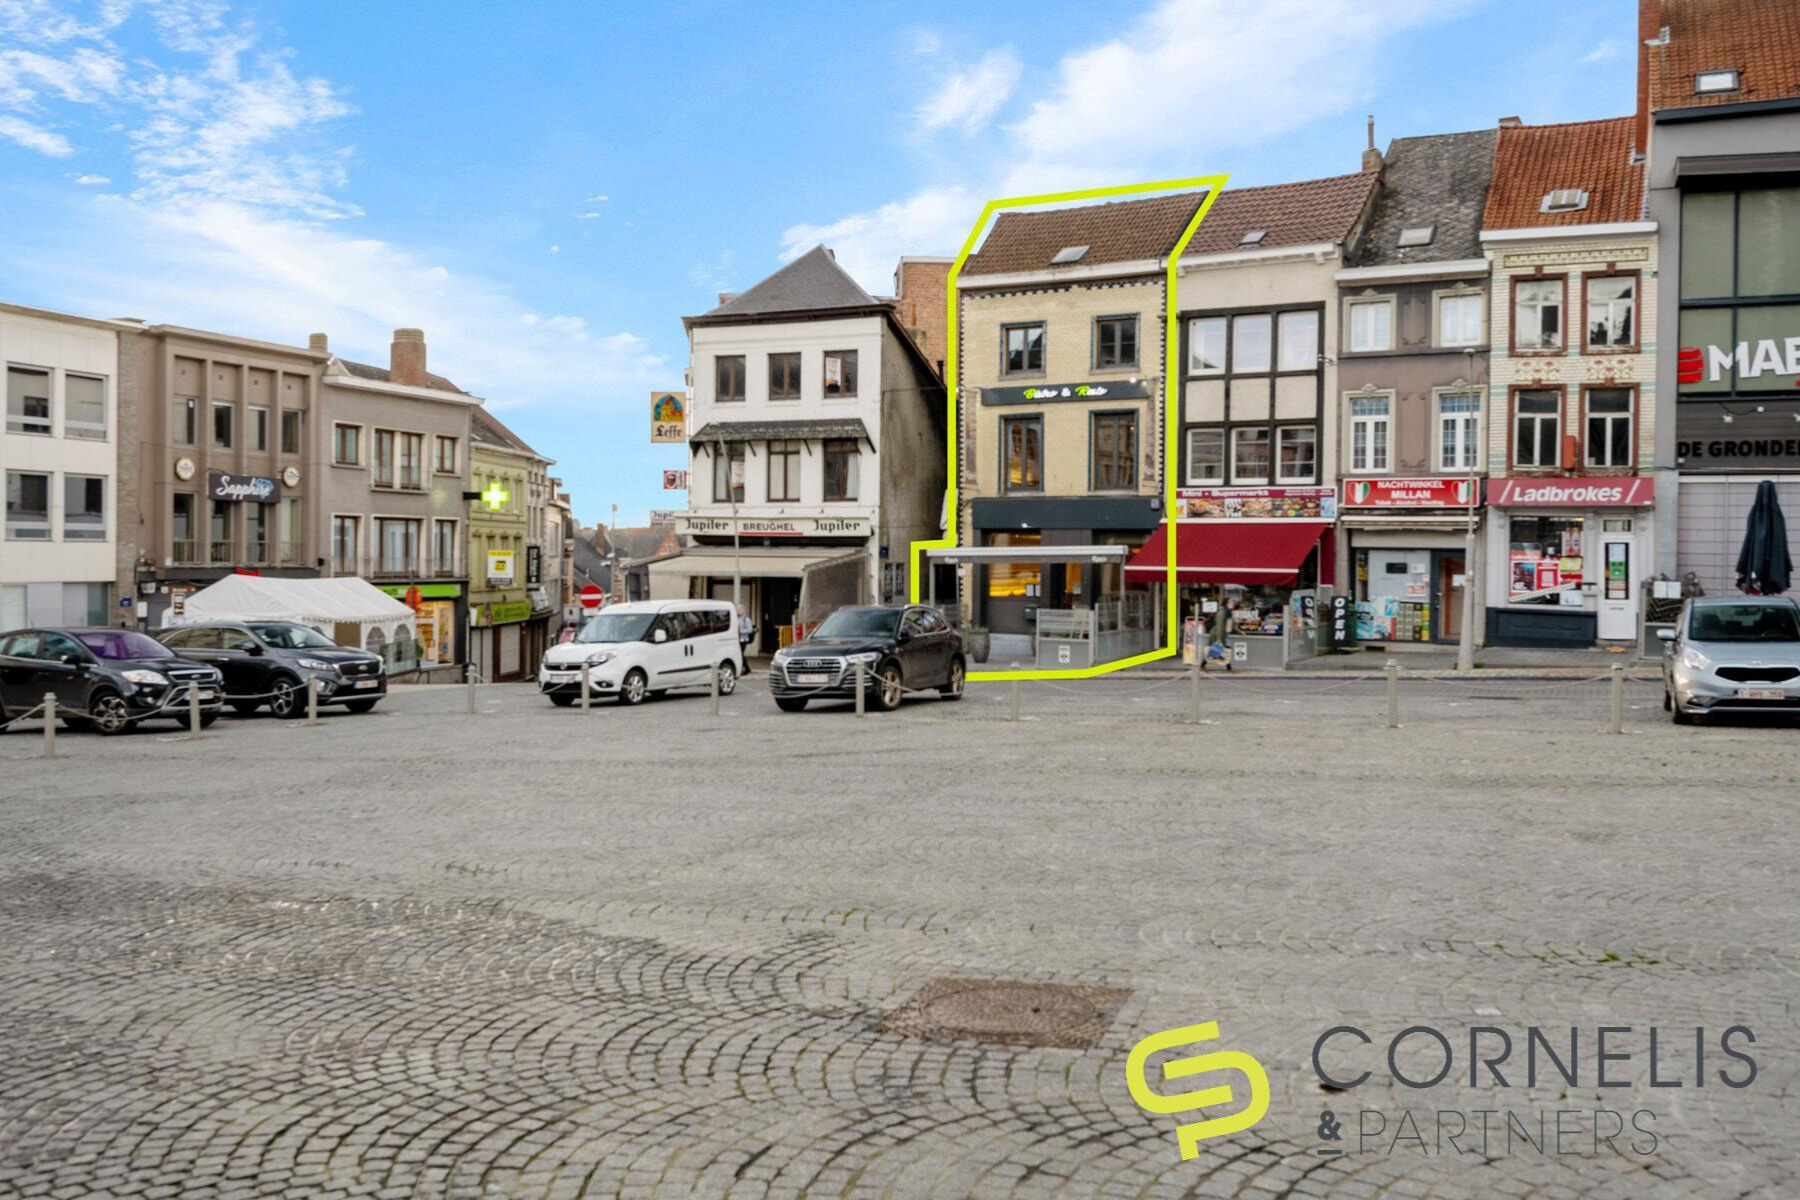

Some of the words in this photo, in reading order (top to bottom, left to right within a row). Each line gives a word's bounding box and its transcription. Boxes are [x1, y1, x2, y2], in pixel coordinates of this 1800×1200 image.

[656, 425, 682, 439] Leffe
[1677, 441, 1703, 457] DE
[1708, 440, 1800, 457] GRONDE
[216, 475, 272, 500] Sapphire
[1377, 480, 1445, 489] NACHTWINKEL
[1182, 489, 1202, 498] Mini
[1390, 490, 1431, 499] MILLAN
[1512, 485, 1623, 502] Ladbrokes
[685, 518, 729, 532] Jupiler
[742, 522, 796, 532] BREUGHEL
[813, 518, 860, 532] Jupiler
[1334, 597, 1345, 640] OPEN
